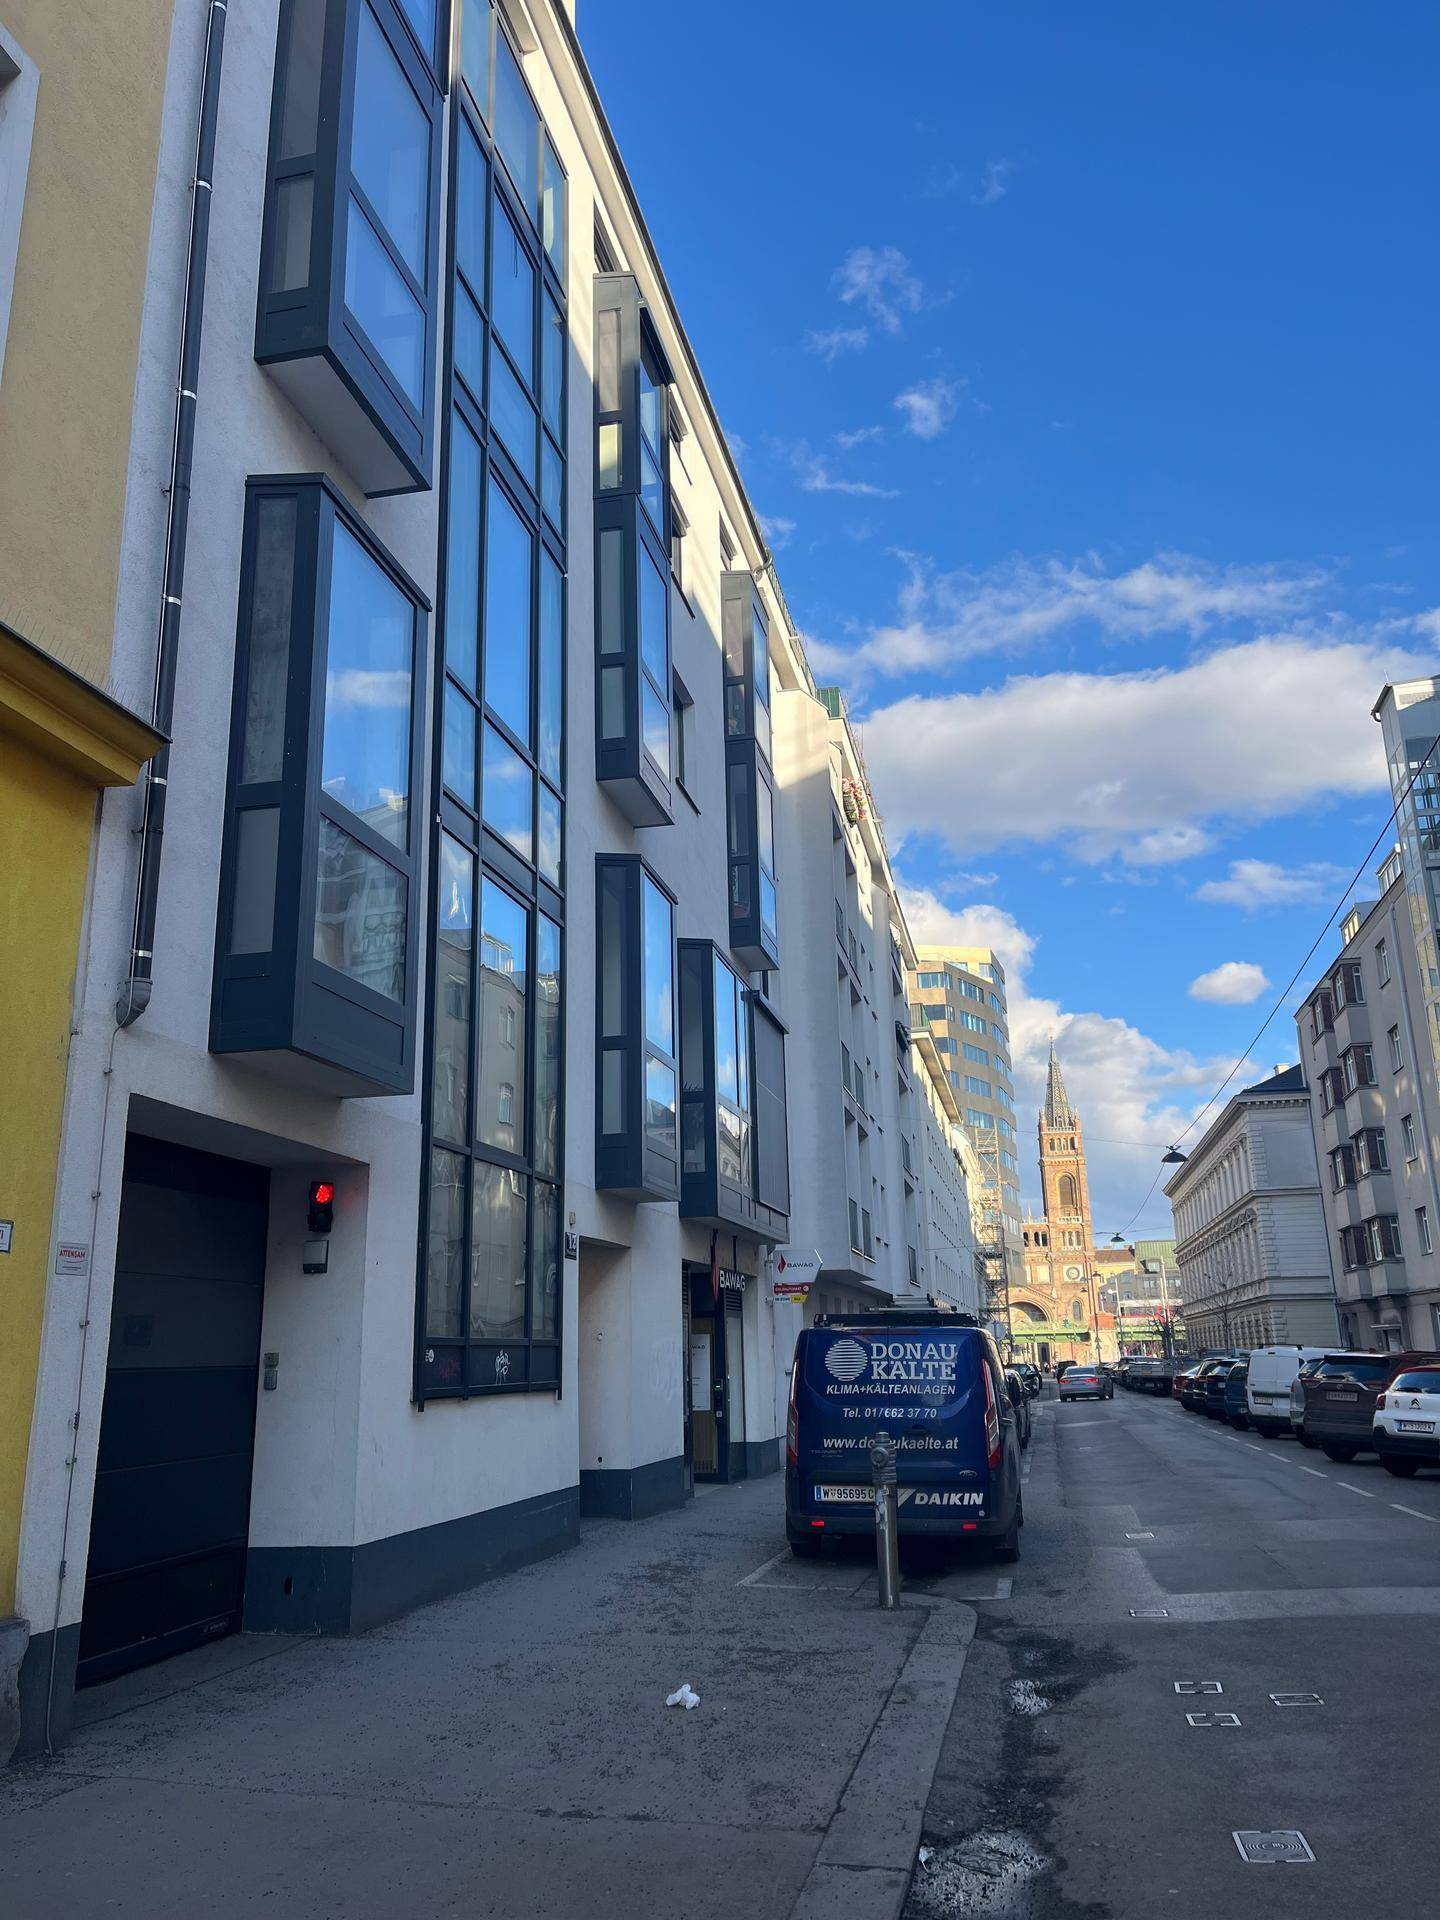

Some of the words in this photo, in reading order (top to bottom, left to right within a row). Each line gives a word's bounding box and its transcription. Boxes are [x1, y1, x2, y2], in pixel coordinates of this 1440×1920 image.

[59, 1249, 86, 1258] ATTENSAM
[719, 1269, 746, 1291] BAWAG
[870, 1343, 957, 1360] DONAU
[871, 1361, 956, 1380] KÄLTE
[826, 1383, 956, 1395] KLIMA+KÄLTEANLAGEN
[843, 1408, 861, 1418] Tel.
[907, 1408, 920, 1418] 37
[924, 1408, 937, 1418] 70
[823, 1436, 959, 1449] www.doukaelte.at
[914, 1492, 984, 1505] DAIKIN
